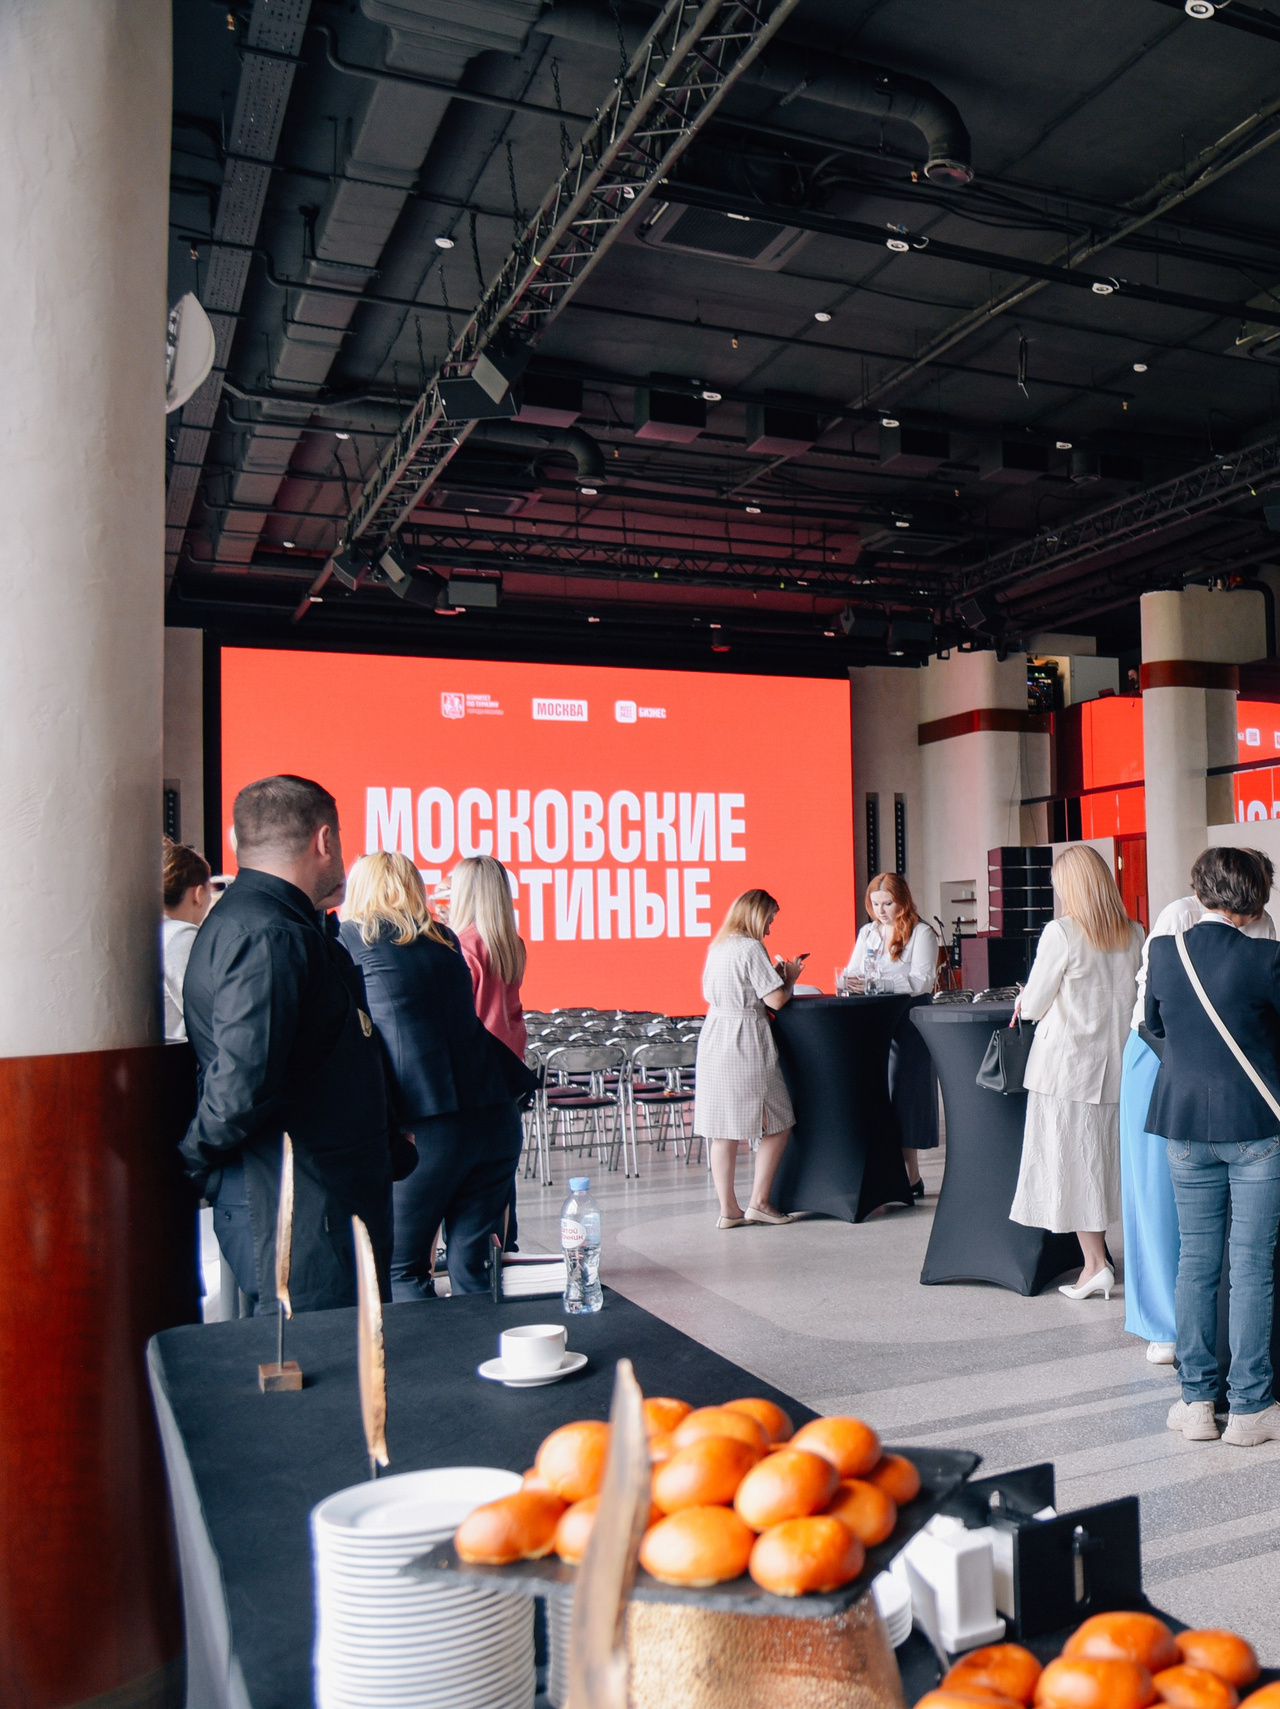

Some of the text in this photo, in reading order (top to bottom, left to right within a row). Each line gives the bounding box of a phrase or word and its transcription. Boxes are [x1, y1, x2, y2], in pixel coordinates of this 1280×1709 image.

[537, 702, 584, 717] МОСКВА
[639, 707, 667, 718] БИЗНЕС
[365, 787, 747, 863] МОСКОВСКИЕ
[424, 868, 712, 941] ТИНЫЕ
